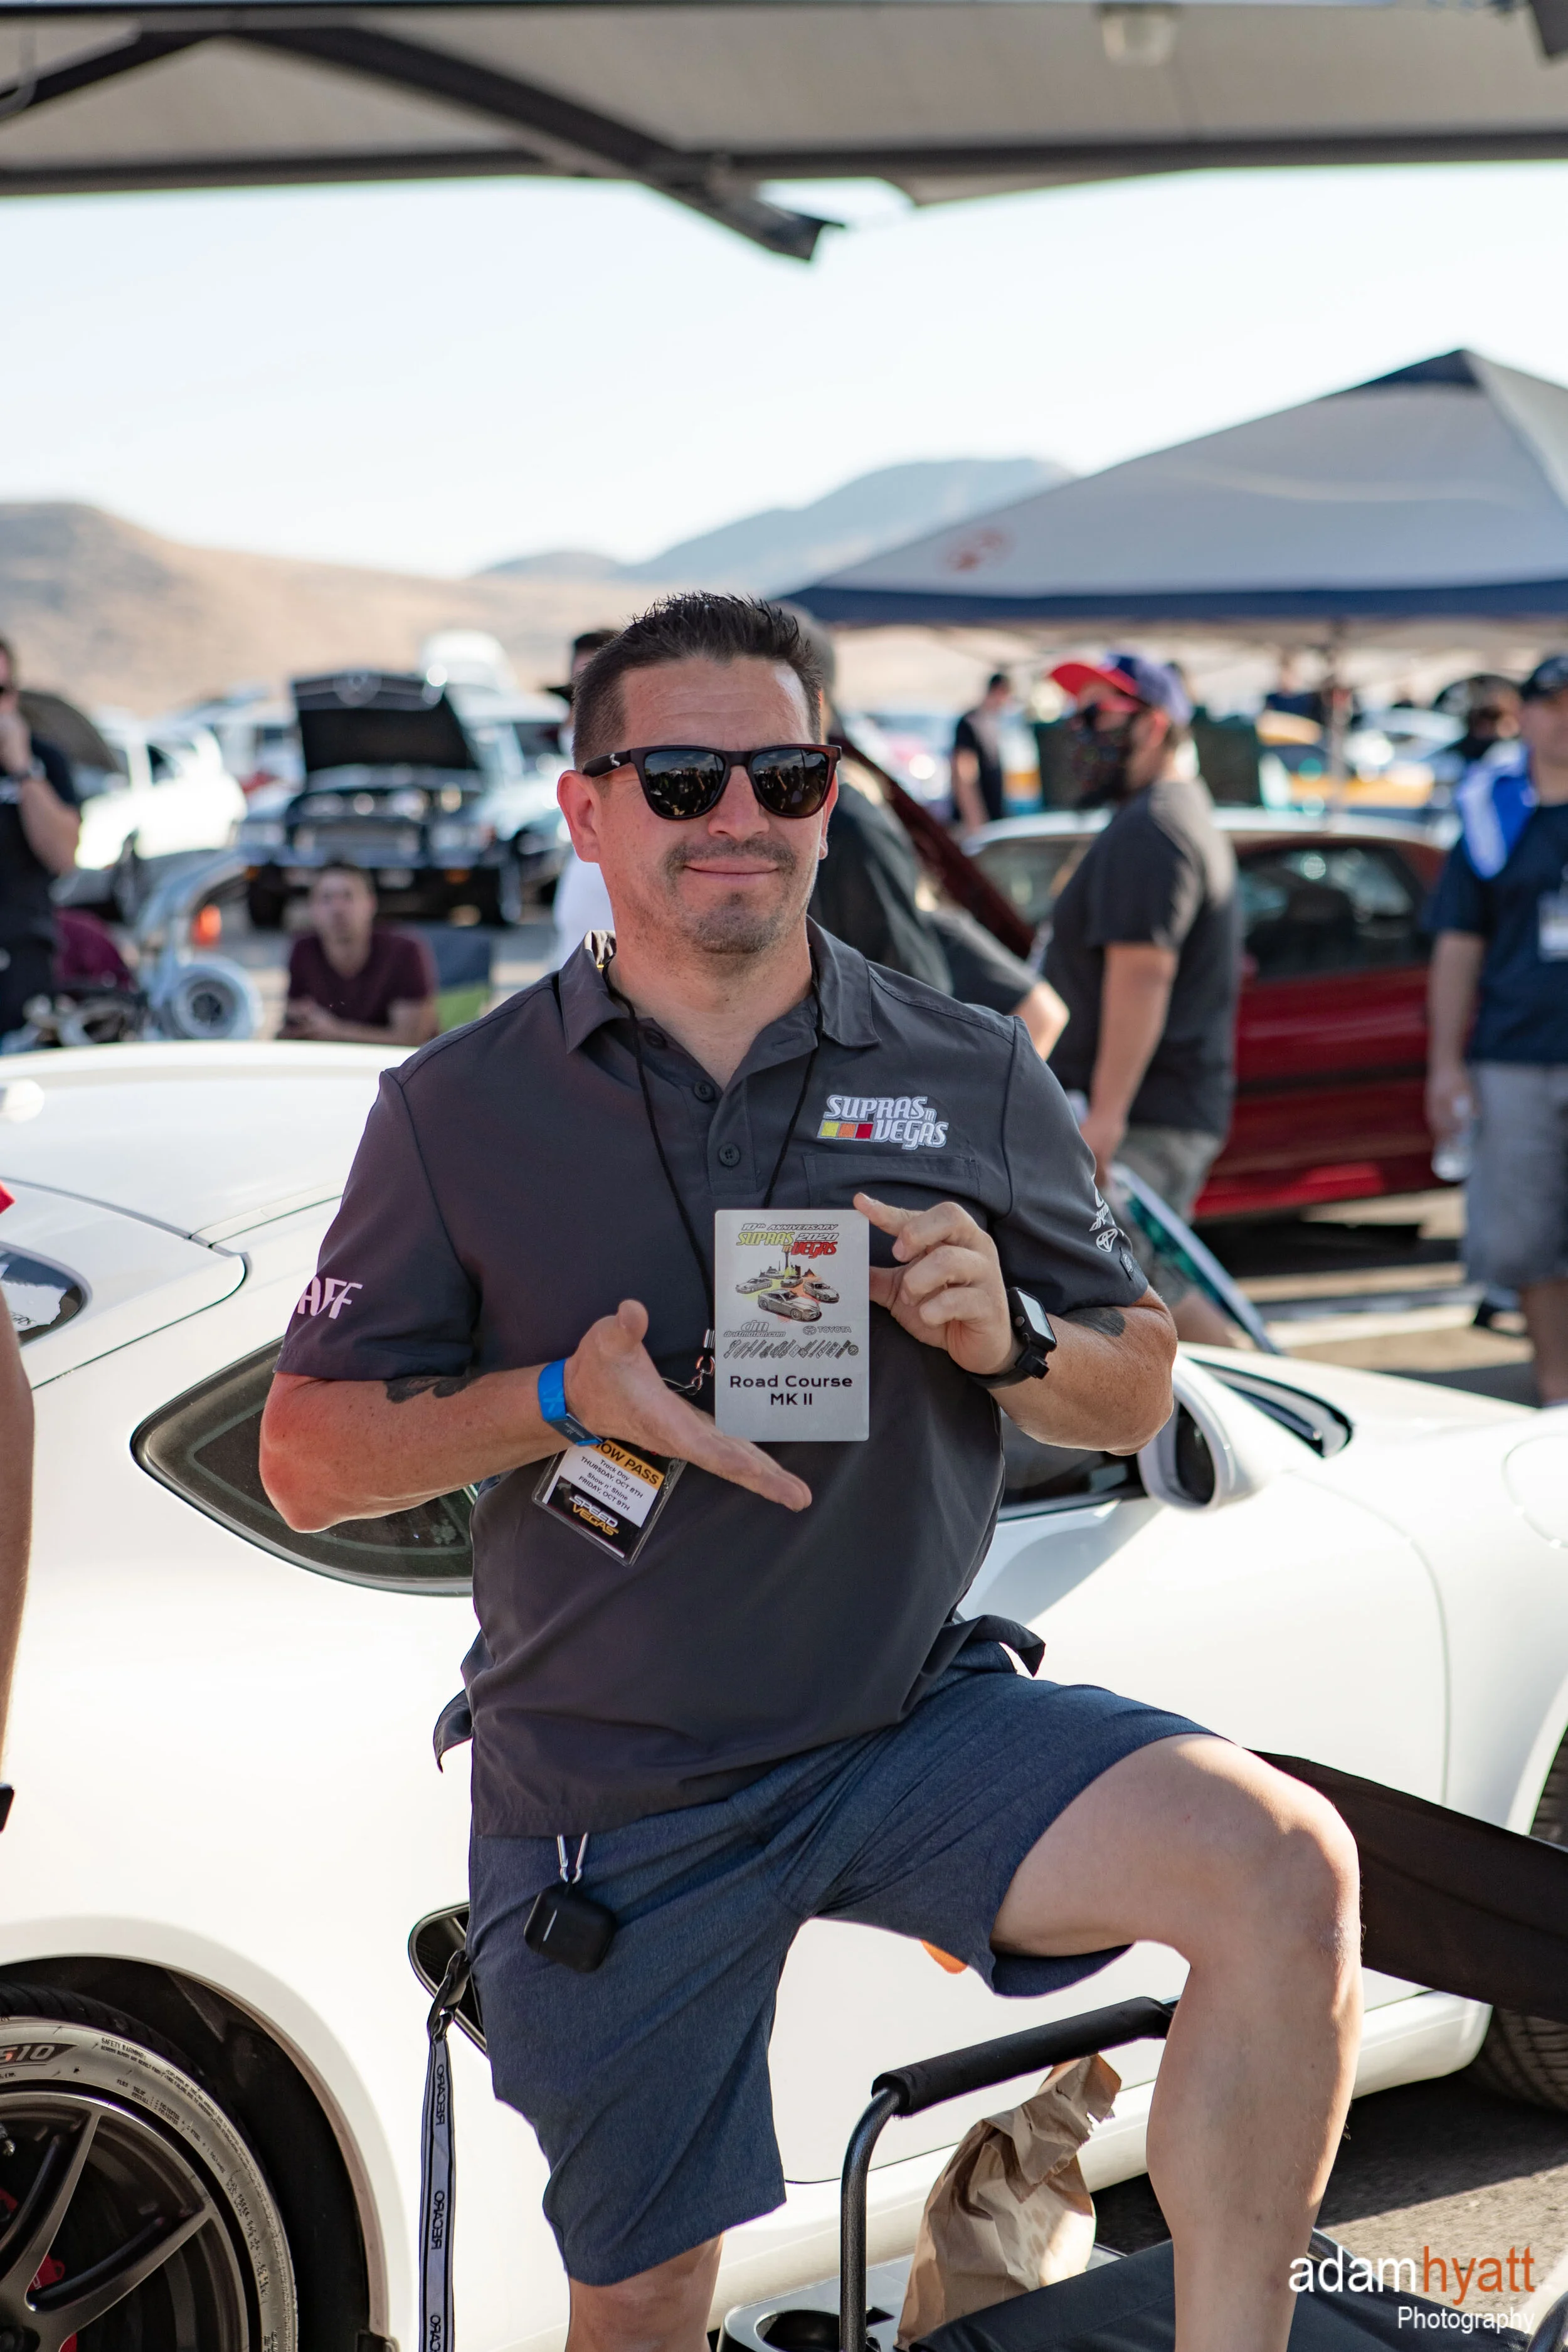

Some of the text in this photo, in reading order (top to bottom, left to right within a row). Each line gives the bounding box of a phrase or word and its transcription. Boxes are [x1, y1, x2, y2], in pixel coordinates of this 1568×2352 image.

[823, 1094, 928, 1121] SUPRAS
[871, 1119, 949, 1150] VEGAS
[741, 1223, 766, 1231] 10th
[736, 1232, 839, 1246] SUPRAS 2020
[790, 1241, 838, 1259] VEGAS
[729, 1375, 853, 1388] Road Course
[770, 1393, 813, 1406] MK II
[596, 1443, 659, 1485] OW PASS
[600, 1459, 630, 1481] Track Day
[587, 1472, 604, 1486] Show
[611, 1487, 628, 1500] Shine
[615, 1480, 630, 1490] OCT
[630, 1487, 644, 1498] 8TH
[569, 1494, 618, 1528] SPEED
[603, 1491, 617, 1502] OCT
[616, 1500, 630, 1511] 9TH
[572, 1503, 619, 1536] VEGAS
